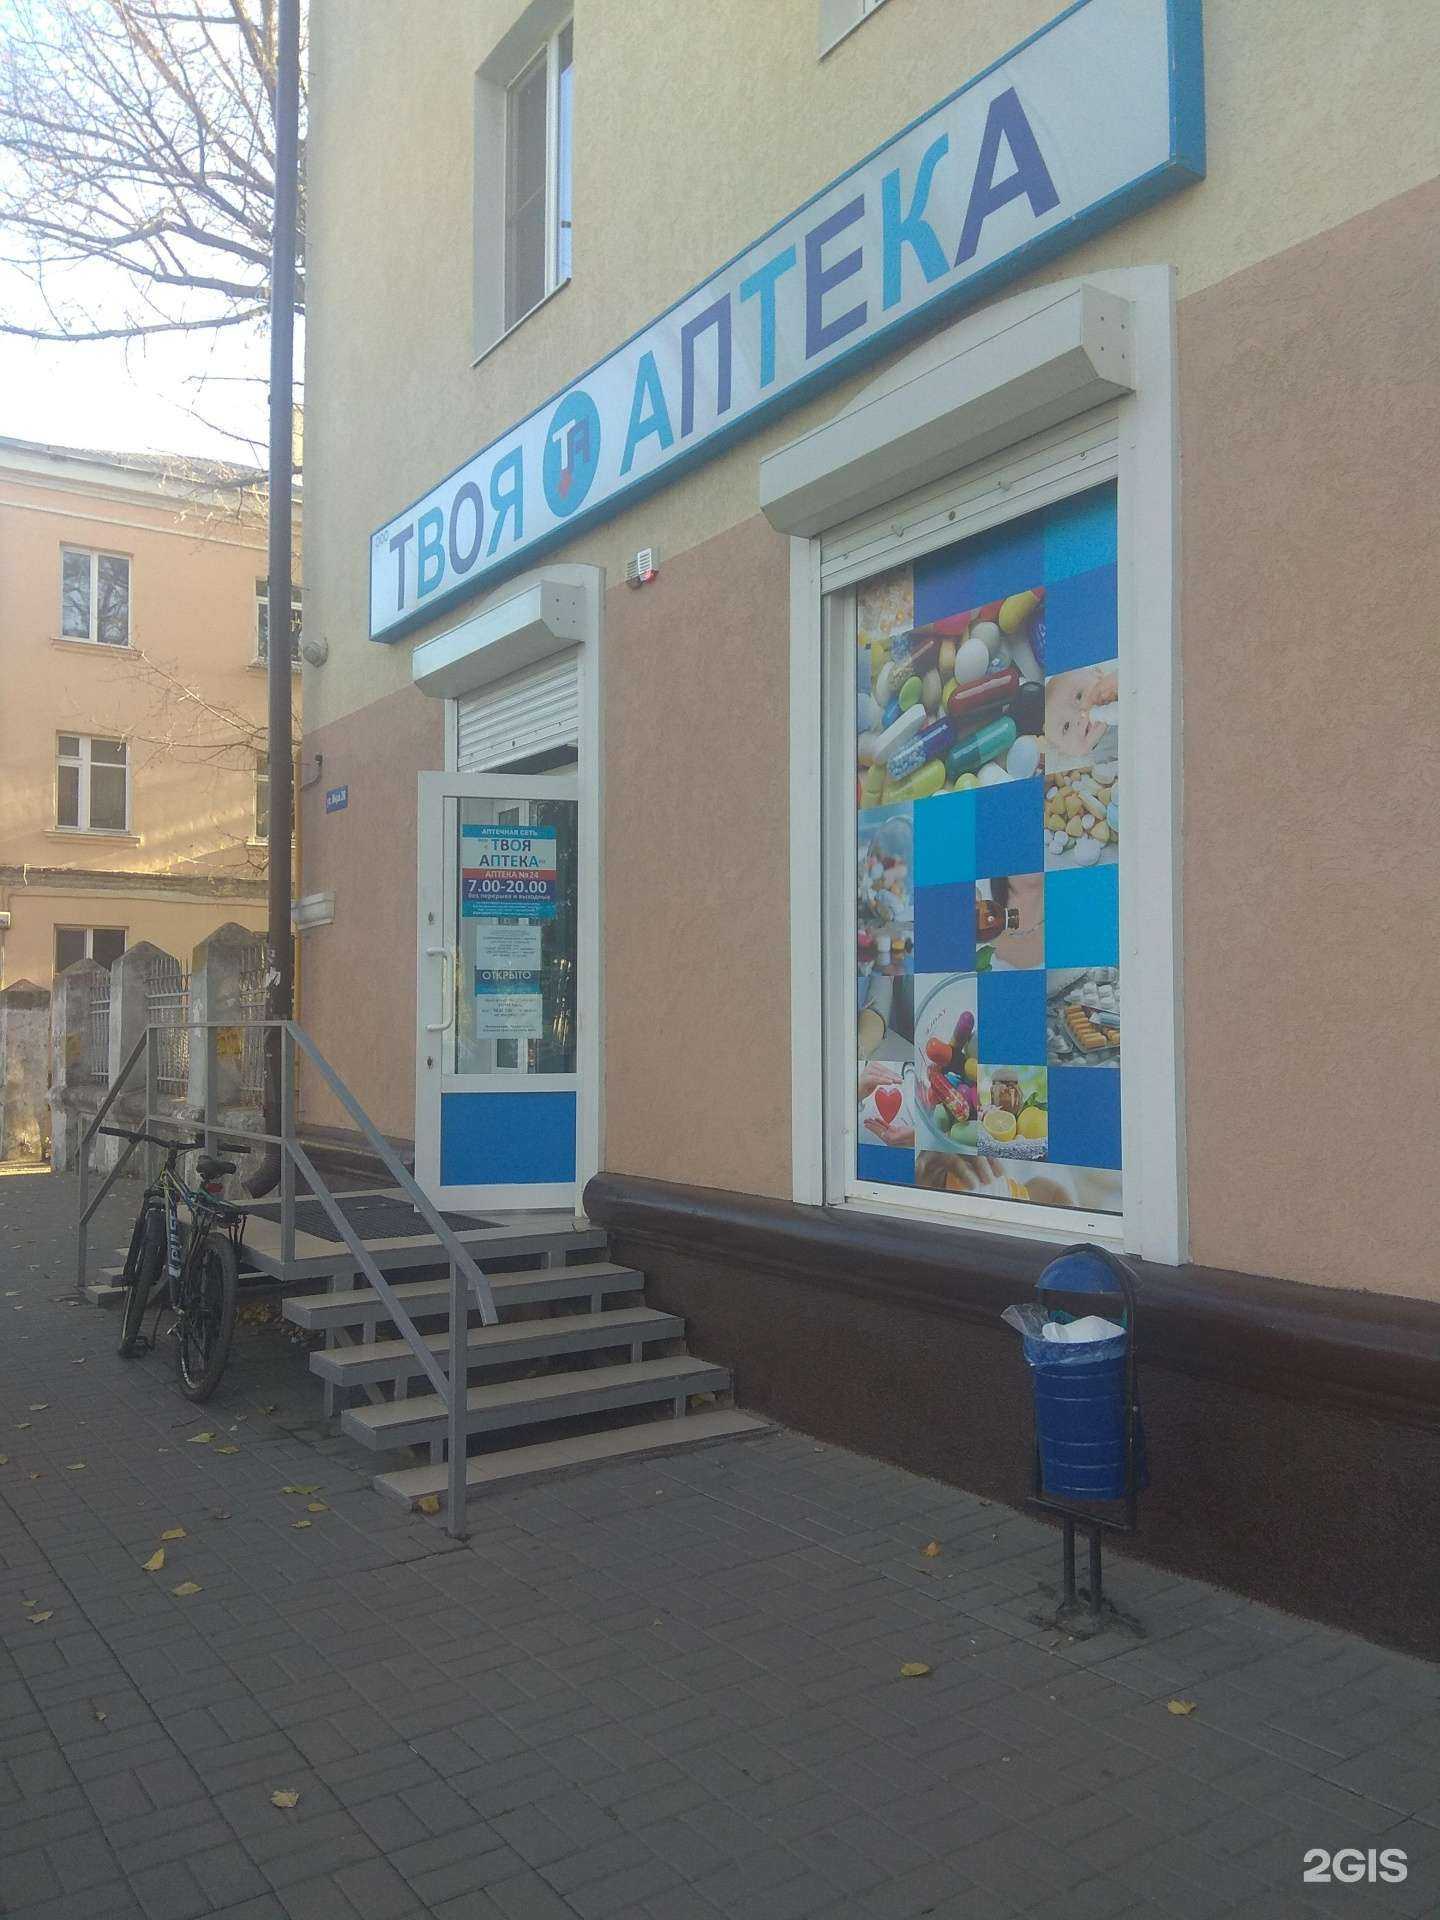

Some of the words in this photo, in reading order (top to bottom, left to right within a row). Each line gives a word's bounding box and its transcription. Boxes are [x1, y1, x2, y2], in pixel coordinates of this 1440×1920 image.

[389, 443, 524, 611] ТВОЯ
[619, 85, 1062, 477] АПТЕКА
[481, 828, 519, 836] АПТЕЧНАЯ
[491, 839, 531, 852] ТВОЯ
[479, 854, 539, 868] АПТЕКА
[485, 870, 518, 879] АПТЕКА
[467, 879, 547, 893] 7.00-20.00
[481, 970, 532, 980] ОТКРЫТО
